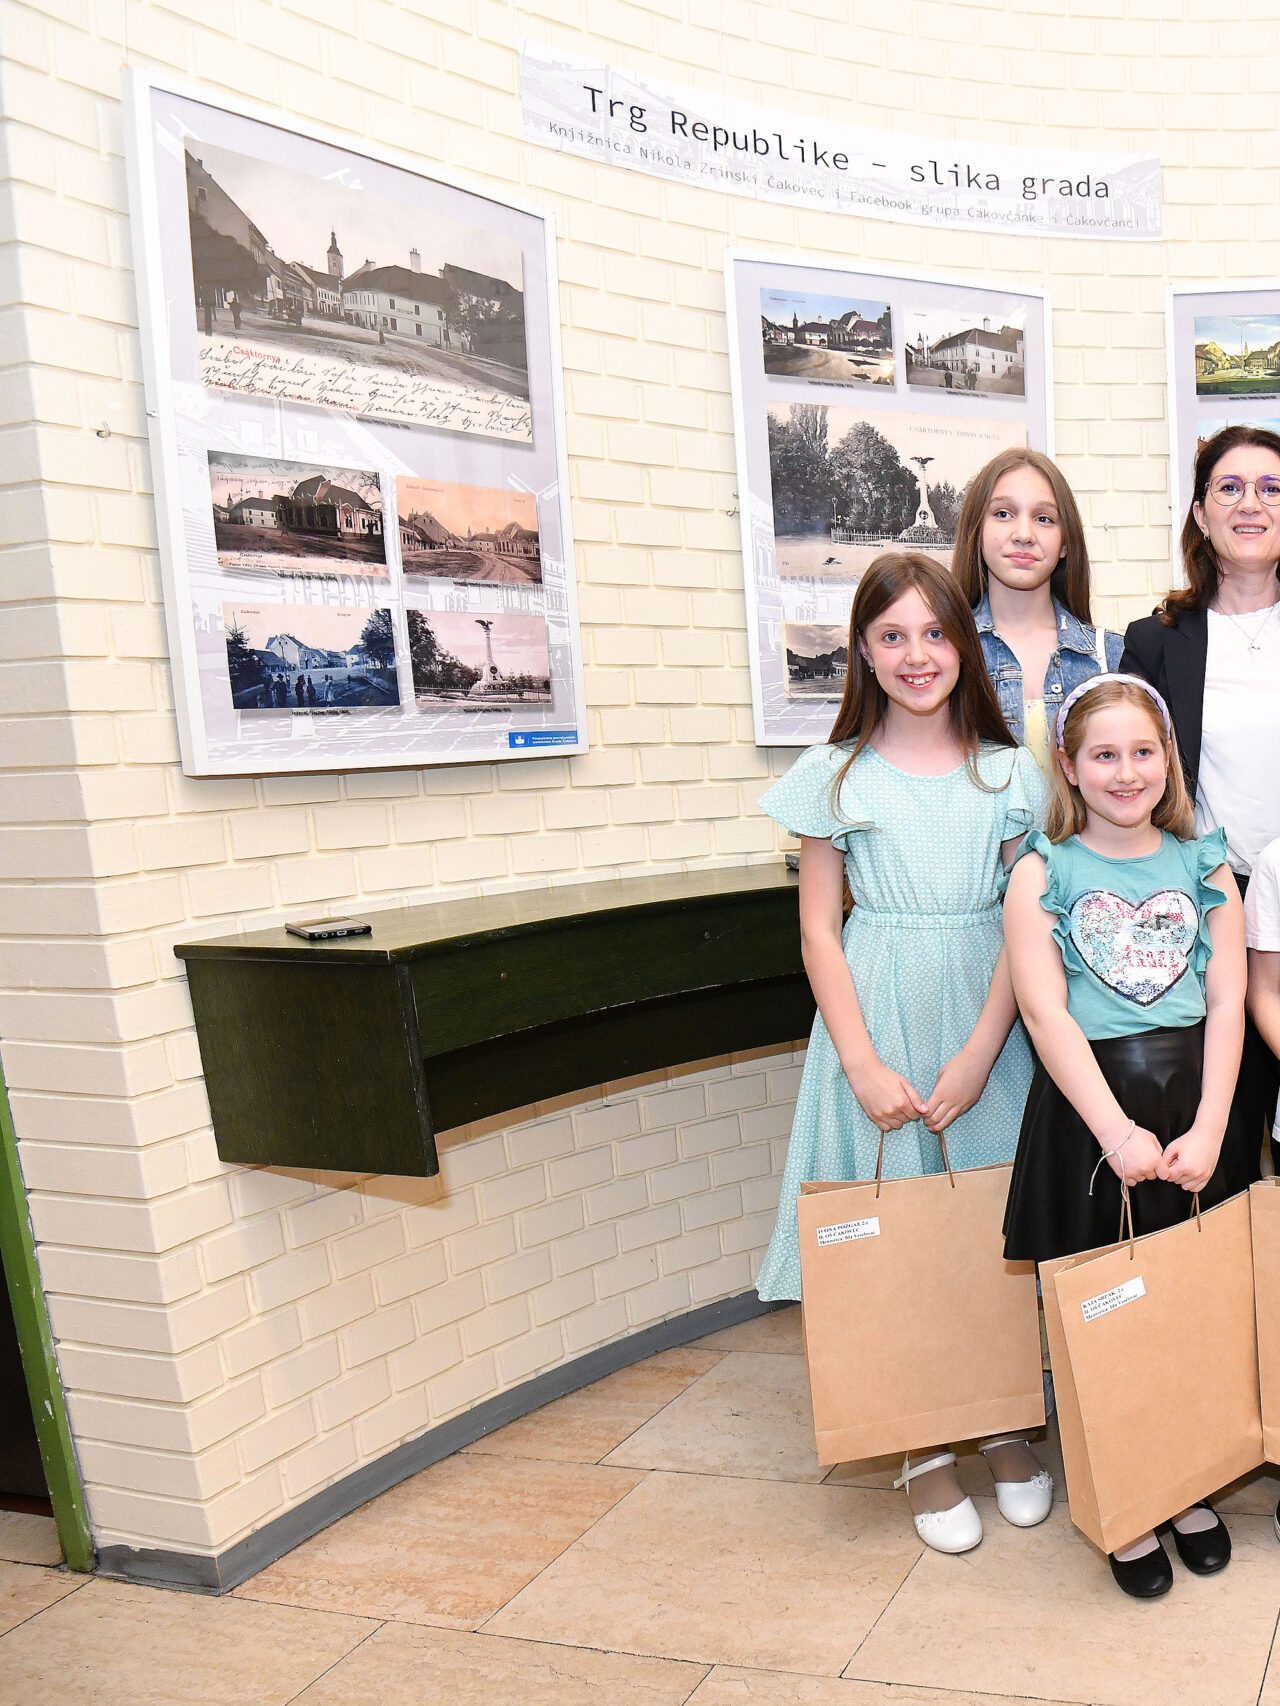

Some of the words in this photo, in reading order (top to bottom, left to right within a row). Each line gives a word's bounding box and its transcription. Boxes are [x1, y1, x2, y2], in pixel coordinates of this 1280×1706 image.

[549, 121, 632, 155] Knjižnica
[639, 147, 692, 171] Nikola
[700, 162, 758, 185] Zrinski
[767, 175, 825, 198] Čakovec
[849, 190, 913, 210] Facebook
[921, 204, 960, 217] grupa
[583, 85, 648, 133] Trg
[671, 110, 850, 170] Republike
[910, 160, 1001, 191] slika
[1022, 174, 1110, 201] grada
[232, 345, 281, 364] Csáktornya
